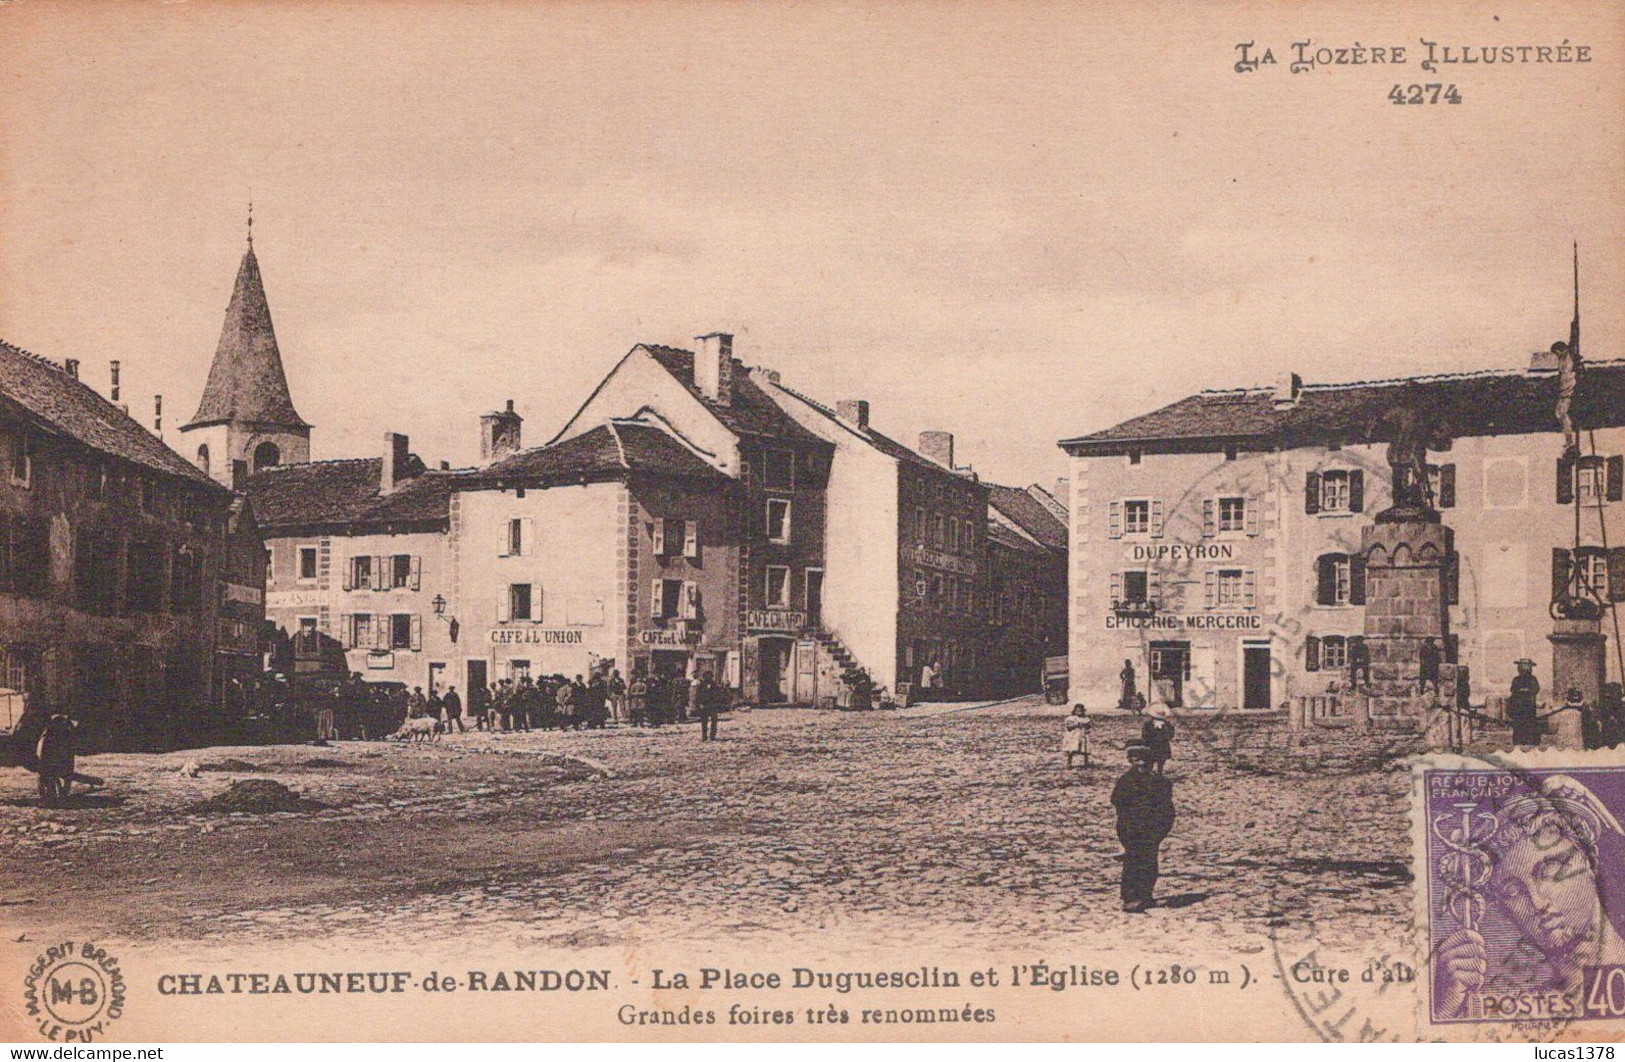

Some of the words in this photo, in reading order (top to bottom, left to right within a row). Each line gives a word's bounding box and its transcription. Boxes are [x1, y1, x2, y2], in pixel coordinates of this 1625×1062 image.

[1387, 83, 1463, 106] 4274
[1133, 545, 1233, 560] DUPEYRON
[651, 969, 690, 990] La
[699, 968, 781, 990] Place
[792, 966, 961, 993] Duguesclin
[970, 968, 1000, 988] et
[1011, 959, 1120, 992] l'Église
[1292, 962, 1350, 983] Cure
[1587, 968, 1625, 1016] 40
[617, 1004, 716, 1026] Grandes
[728, 1003, 794, 1025] foires
[806, 1003, 849, 1025] très
[861, 1002, 996, 1024] renommées
[1483, 994, 1577, 1016] POSTES
